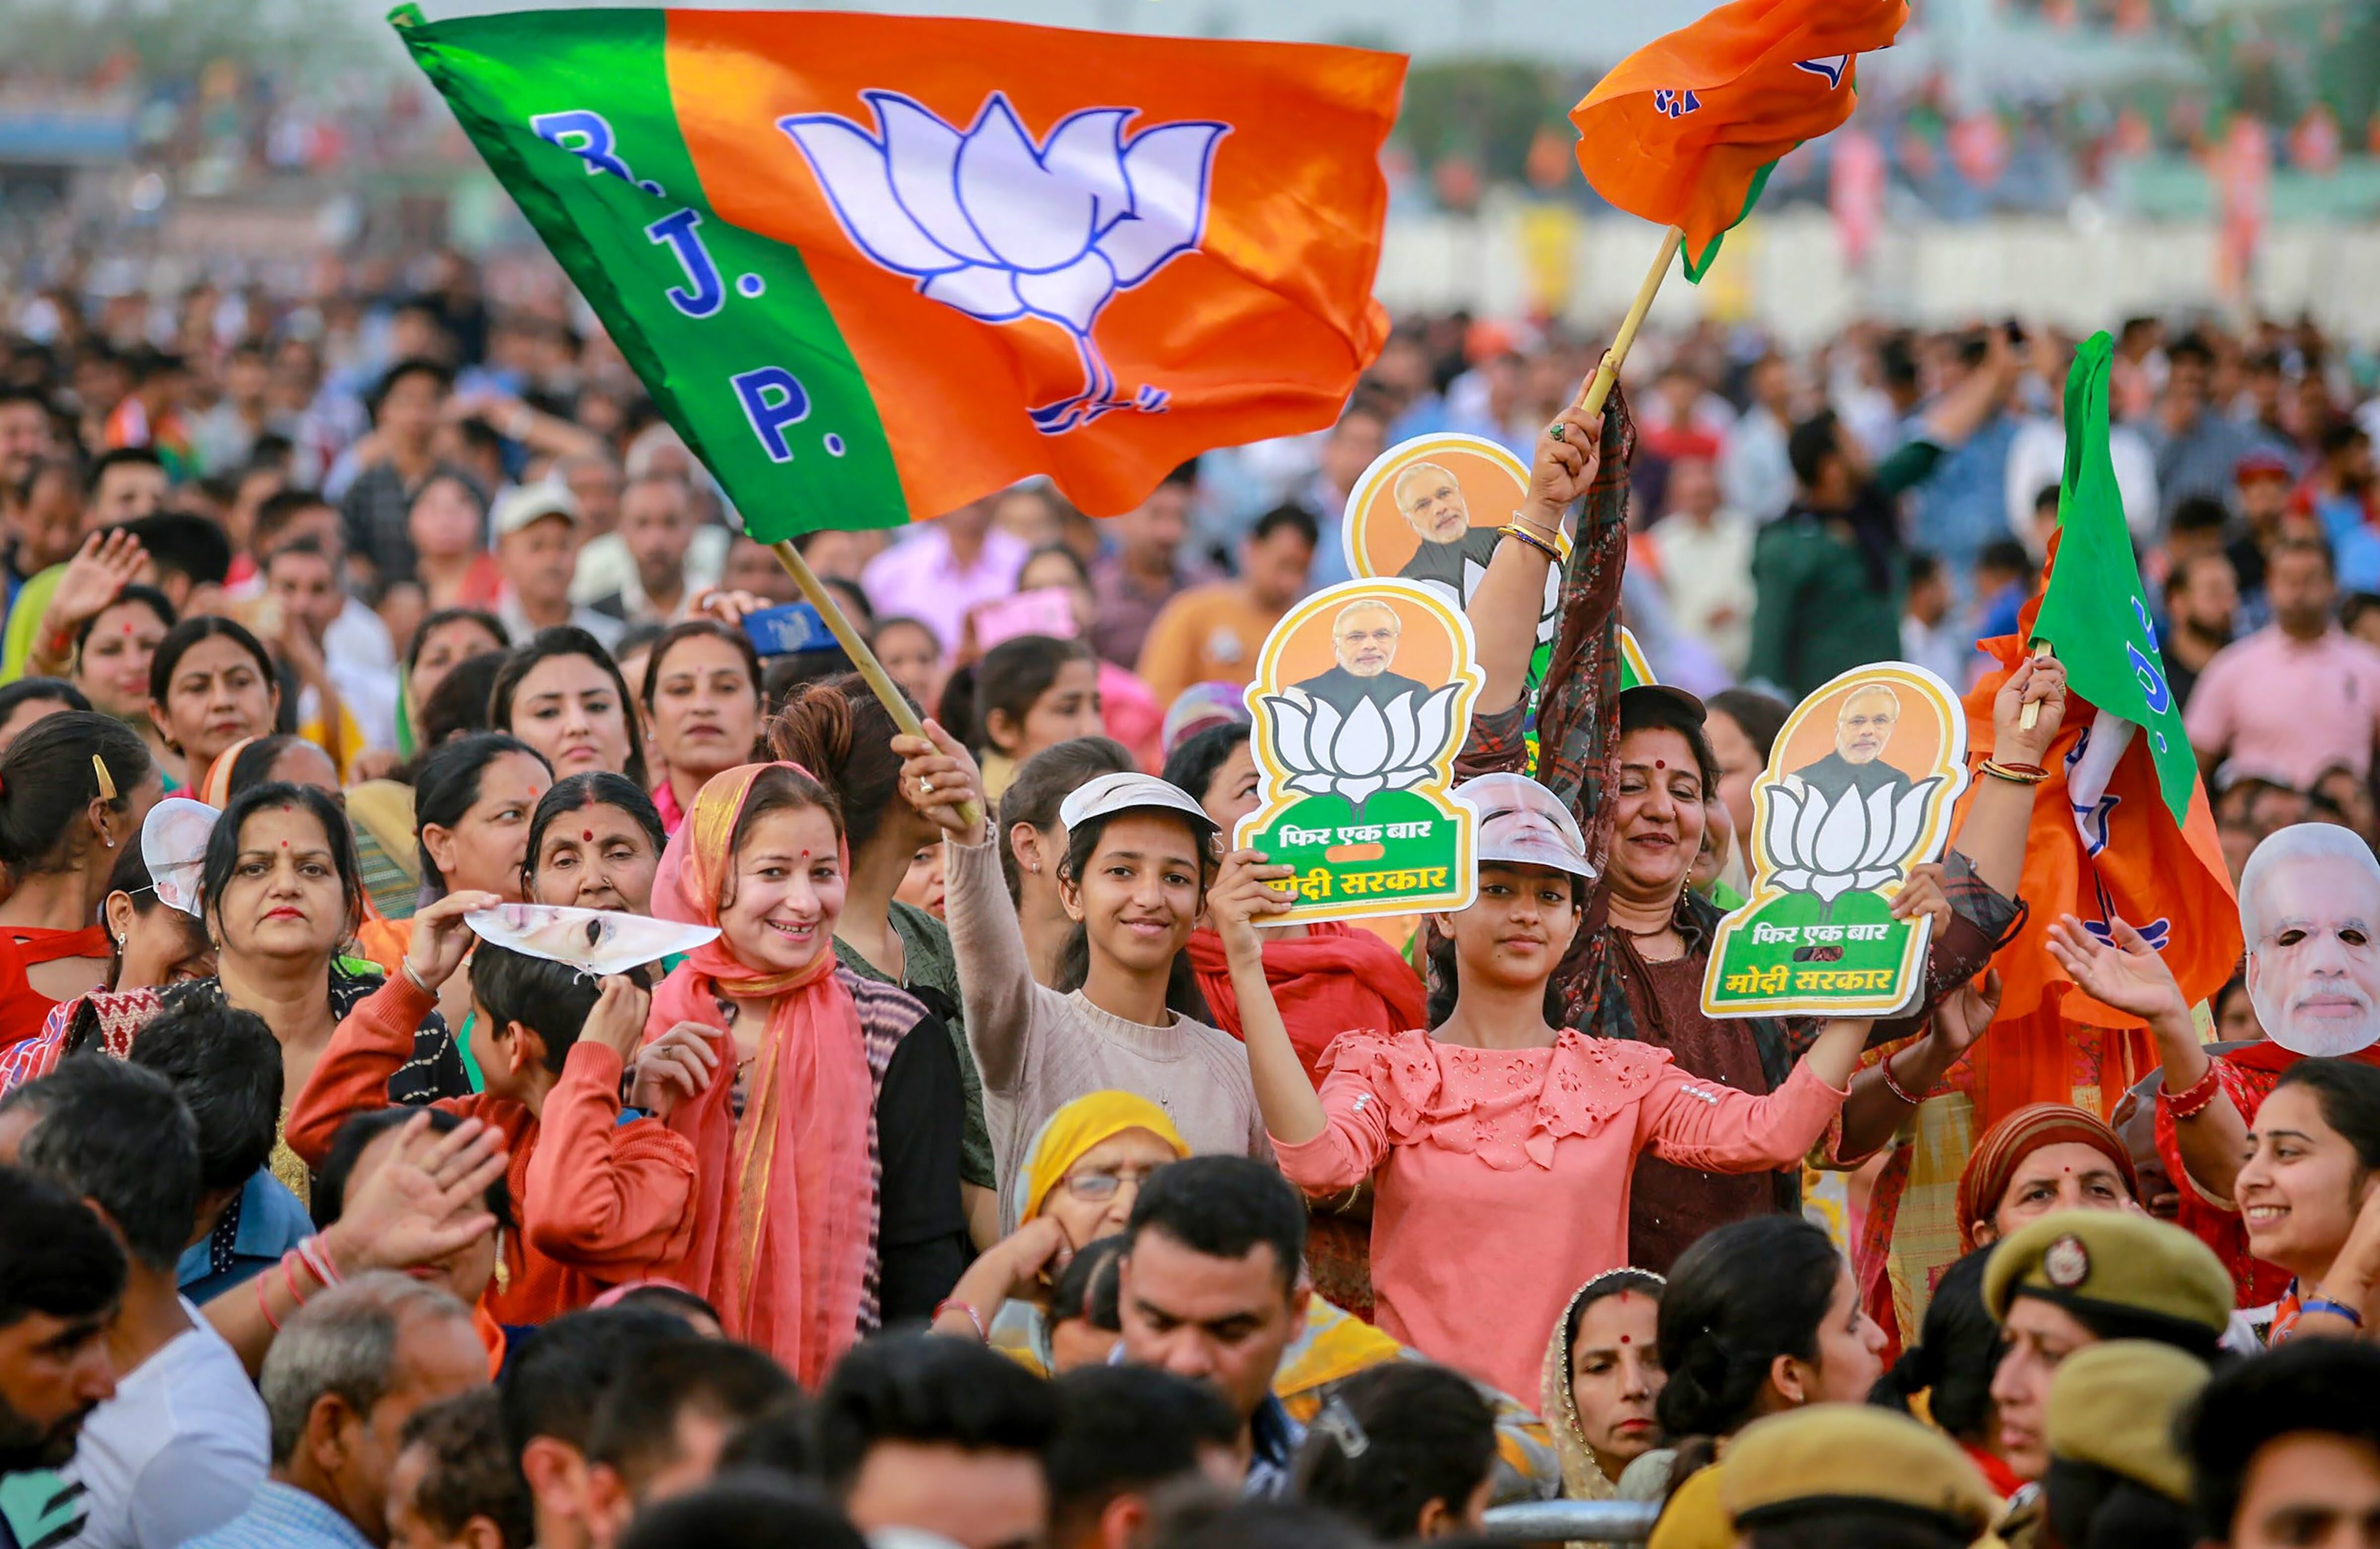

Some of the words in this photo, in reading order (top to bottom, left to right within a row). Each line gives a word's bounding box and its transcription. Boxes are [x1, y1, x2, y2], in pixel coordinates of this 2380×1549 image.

[1279, 825, 1331, 848] फिर
[1336, 824, 1383, 845] एक
[1386, 821, 1431, 838] बार
[1340, 867, 1447, 894] सरकार
[1751, 922, 1800, 945] फिर
[1803, 925, 1844, 946] एक
[1846, 924, 1890, 940] बार
[1726, 965, 1790, 995] मोदी
[1795, 970, 1894, 991] सरकार
